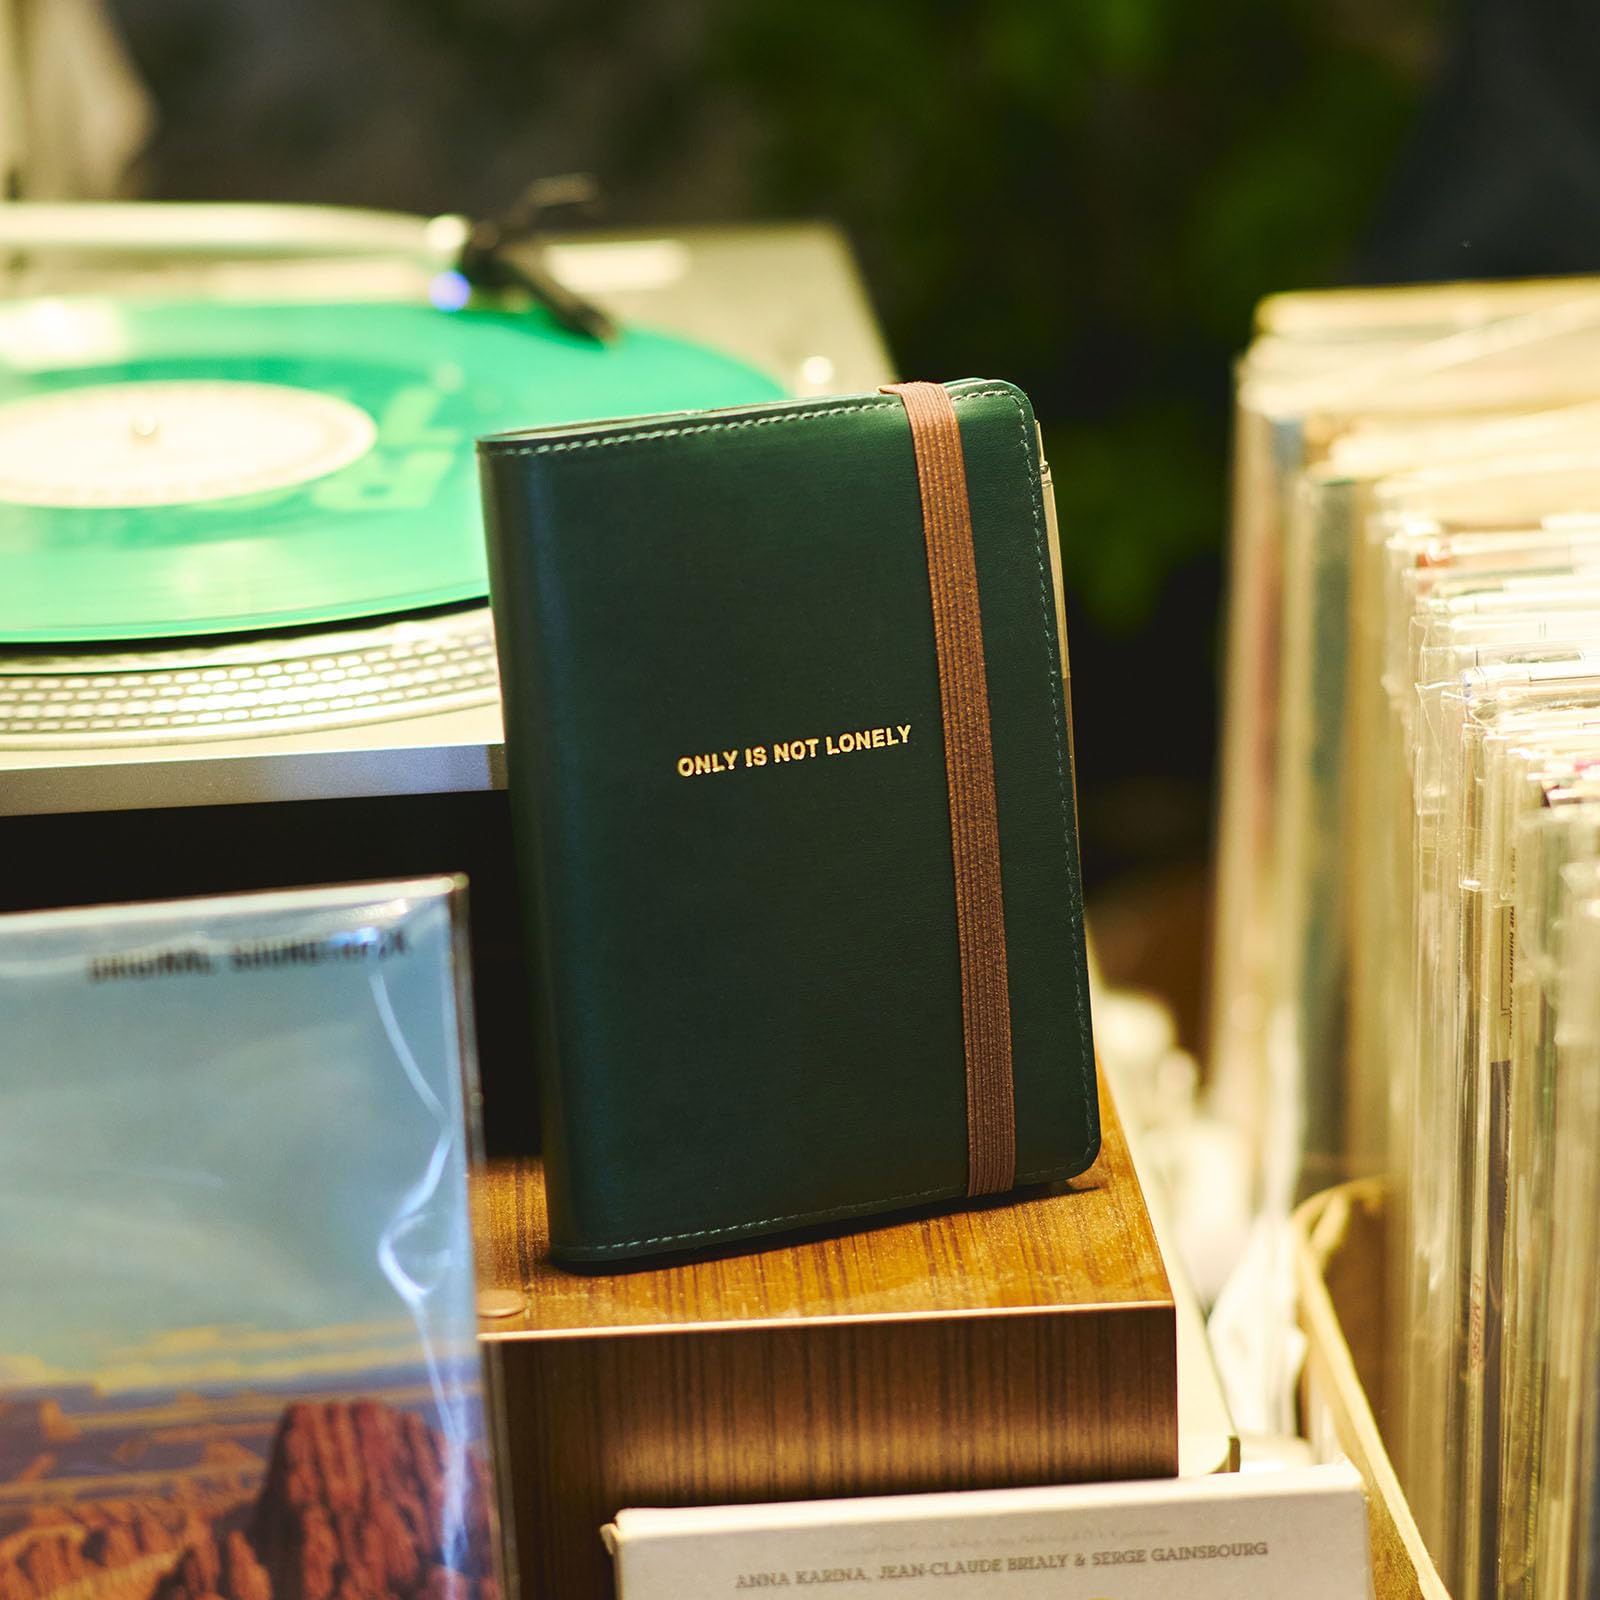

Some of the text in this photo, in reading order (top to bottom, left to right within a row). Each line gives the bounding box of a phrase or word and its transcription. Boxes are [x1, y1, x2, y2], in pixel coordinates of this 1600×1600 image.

[677, 724, 912, 777] ONLY IS NOT LONELY
[734, 1572, 791, 1589] ANNA
[1007, 1553, 1068, 1572] BRIALY
[1074, 1553, 1086, 1568] &
[1091, 1549, 1147, 1567] SERGE
[1151, 1541, 1269, 1563] GAINSBOURG
